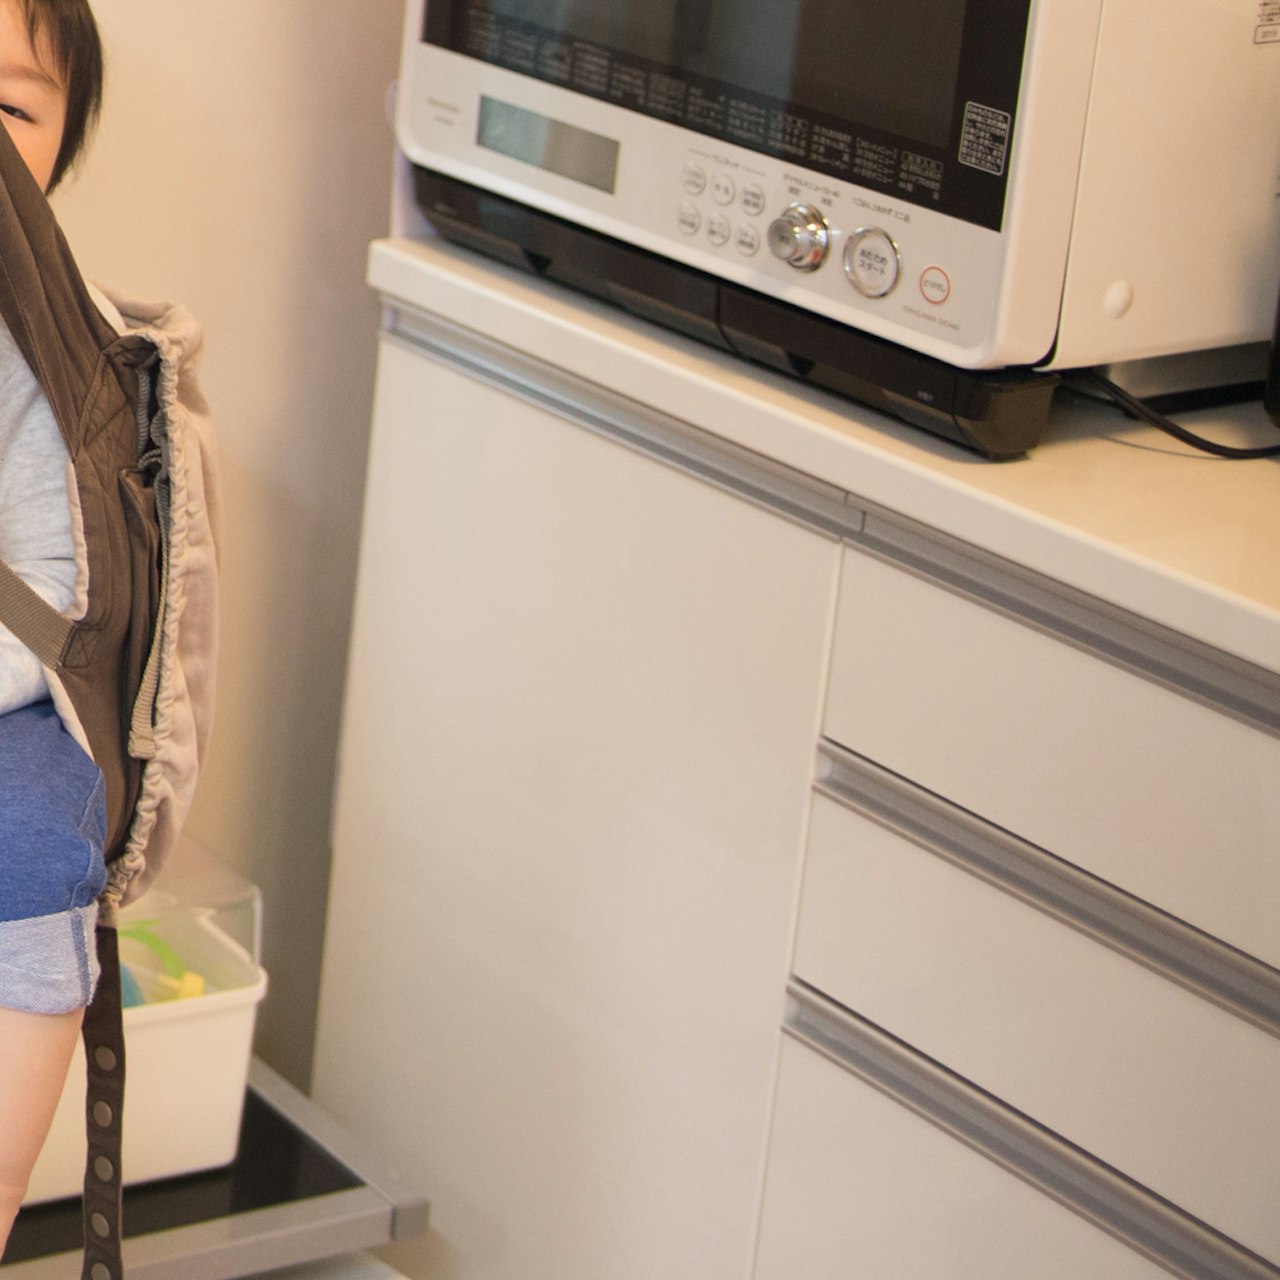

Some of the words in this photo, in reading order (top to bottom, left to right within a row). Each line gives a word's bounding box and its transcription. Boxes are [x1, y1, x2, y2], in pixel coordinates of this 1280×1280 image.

[859, 248, 889, 267] あたため
[858, 259, 886, 276] スタート
